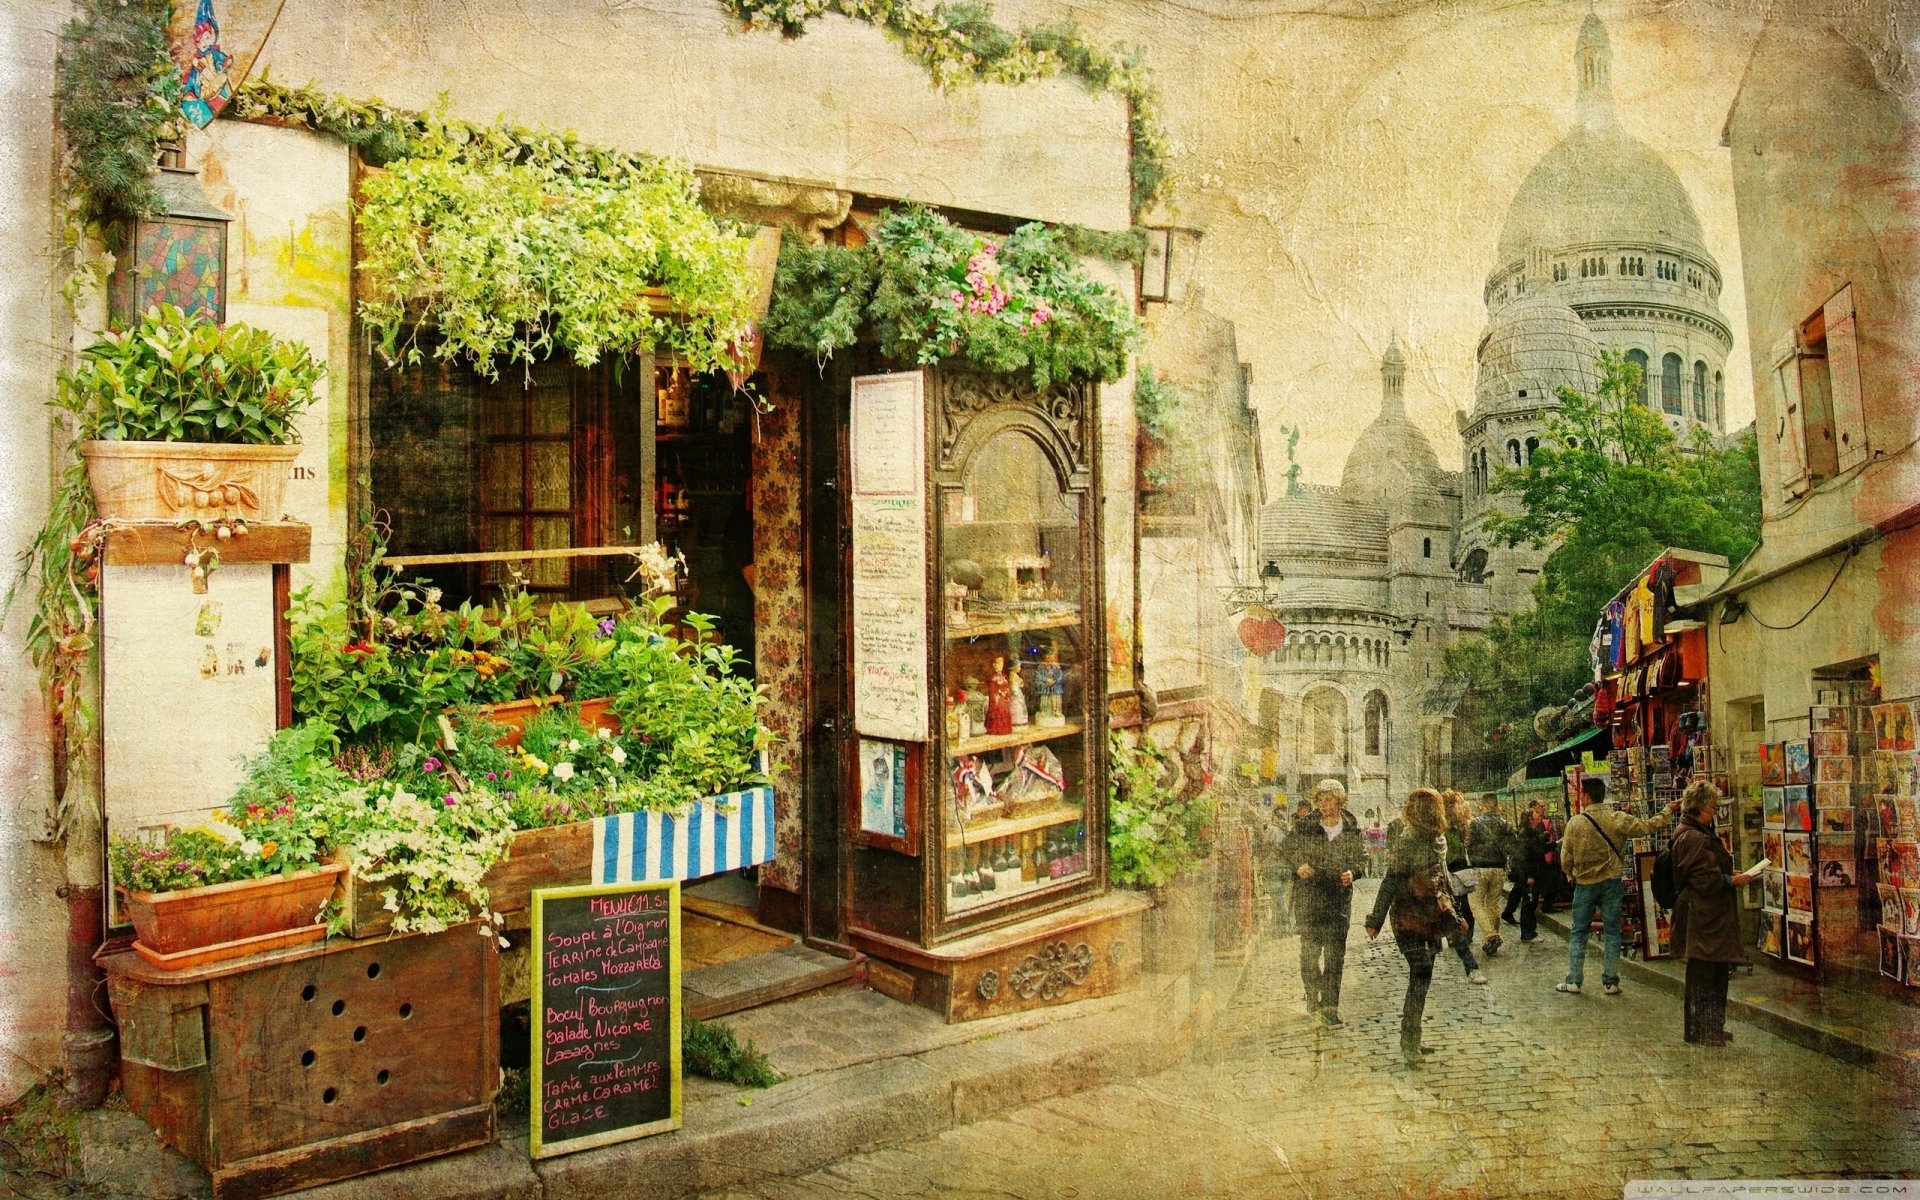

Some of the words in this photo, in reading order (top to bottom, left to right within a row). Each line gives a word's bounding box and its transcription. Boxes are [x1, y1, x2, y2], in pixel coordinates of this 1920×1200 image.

[288, 466, 316, 480] ns
[602, 924, 613, 939] à
[545, 1022, 592, 1045] Salade
[545, 1040, 621, 1066] Lasagnes
[589, 1072, 614, 1085] aux
